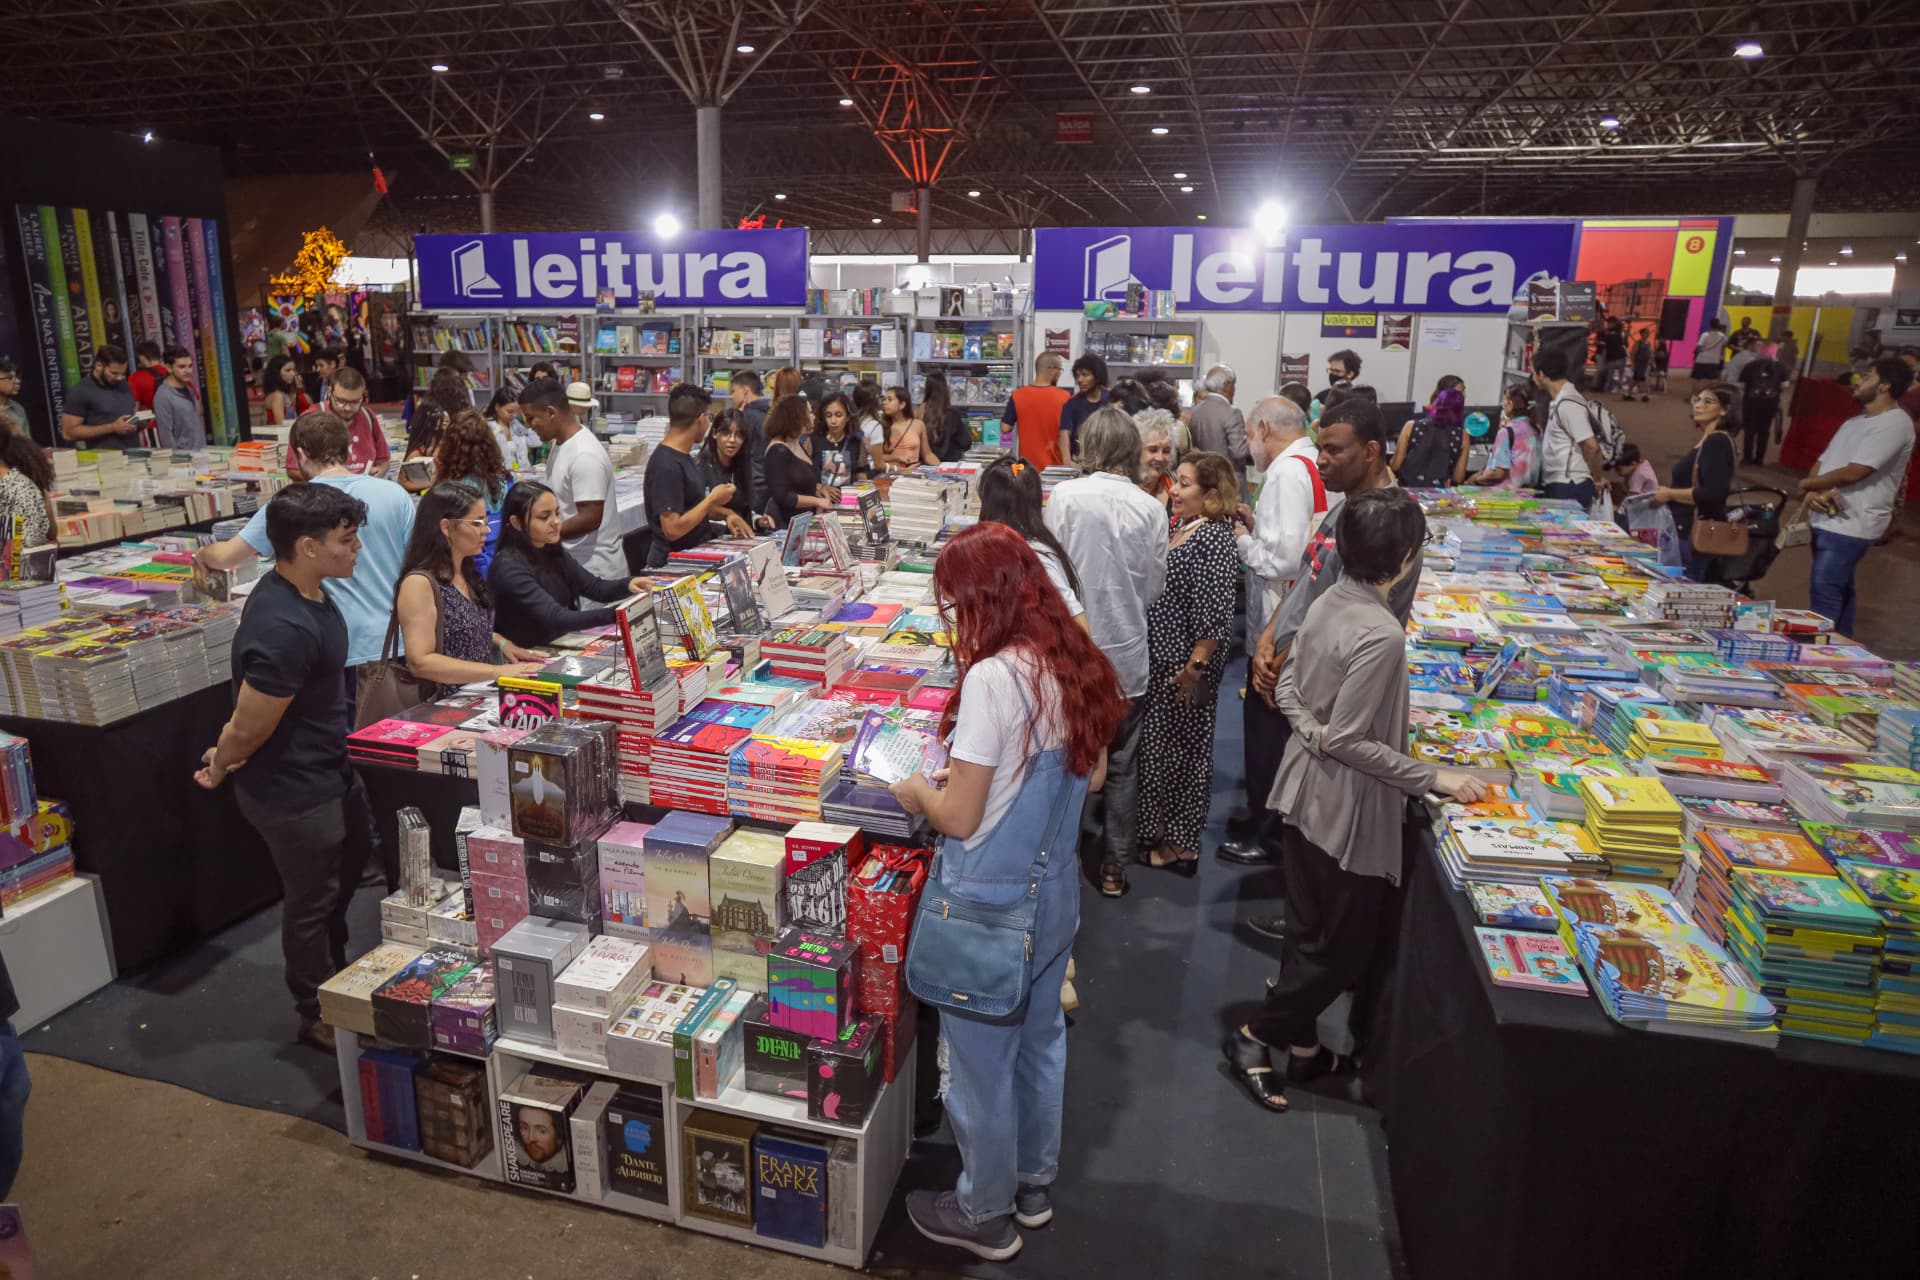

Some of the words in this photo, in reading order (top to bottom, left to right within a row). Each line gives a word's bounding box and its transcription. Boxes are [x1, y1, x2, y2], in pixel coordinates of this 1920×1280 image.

[22, 217, 35, 256] ASHER
[30, 212, 45, 261] LAUREN
[513, 237, 769, 299] leitura
[1172, 233, 1517, 306] leitura
[42, 317, 54, 347] NAS
[1324, 315, 1348, 327] vale
[1350, 313, 1375, 327] livro
[46, 347, 64, 432] ENTRELINH
[461, 866, 472, 889] VELHO
[799, 942, 829, 955] DUNA
[757, 1035, 801, 1060] DUNA
[500, 1101, 520, 1182] SHAKESPEARE
[615, 1165, 664, 1185] ALIGHIERI
[620, 1153, 657, 1171] DANTE
[759, 1154, 818, 1181] FRANZ
[759, 1168, 818, 1194] KAFKA
